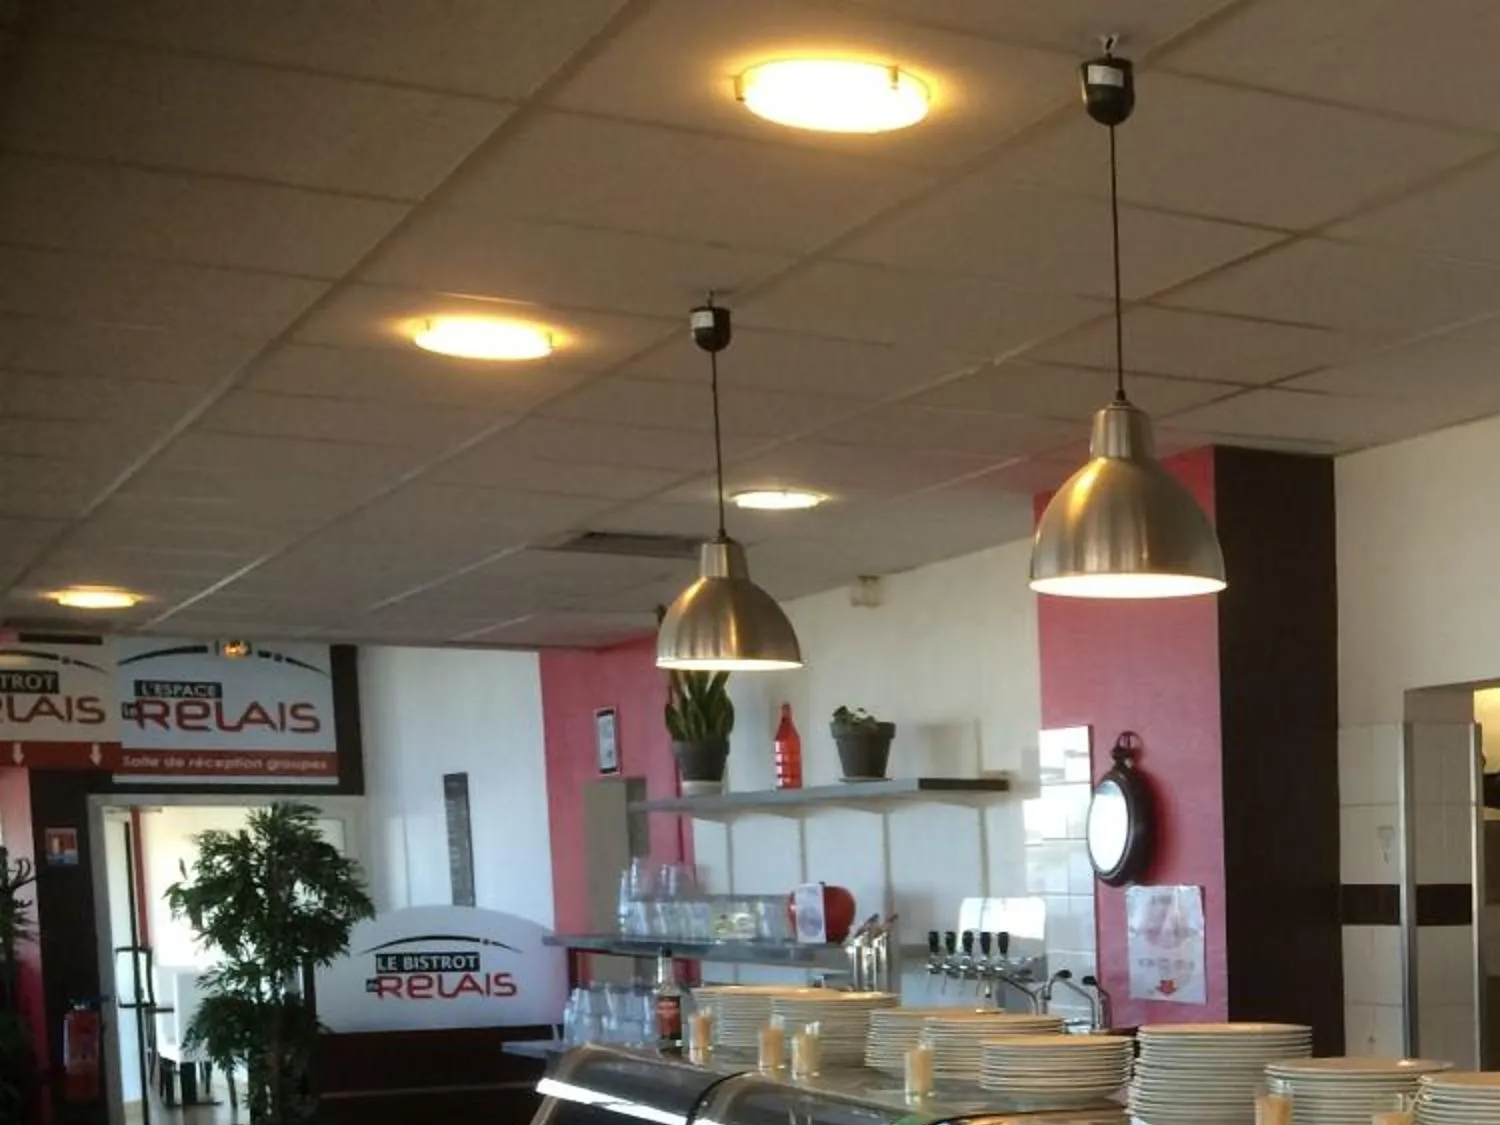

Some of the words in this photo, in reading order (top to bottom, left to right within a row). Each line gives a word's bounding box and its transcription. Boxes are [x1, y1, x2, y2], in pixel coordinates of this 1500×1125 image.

[162, 756, 186, 768] de
[188, 757, 263, 771] réception
[265, 759, 328, 771] groupes
[377, 955, 398, 971] LE
[403, 954, 478, 971] BISTROT
